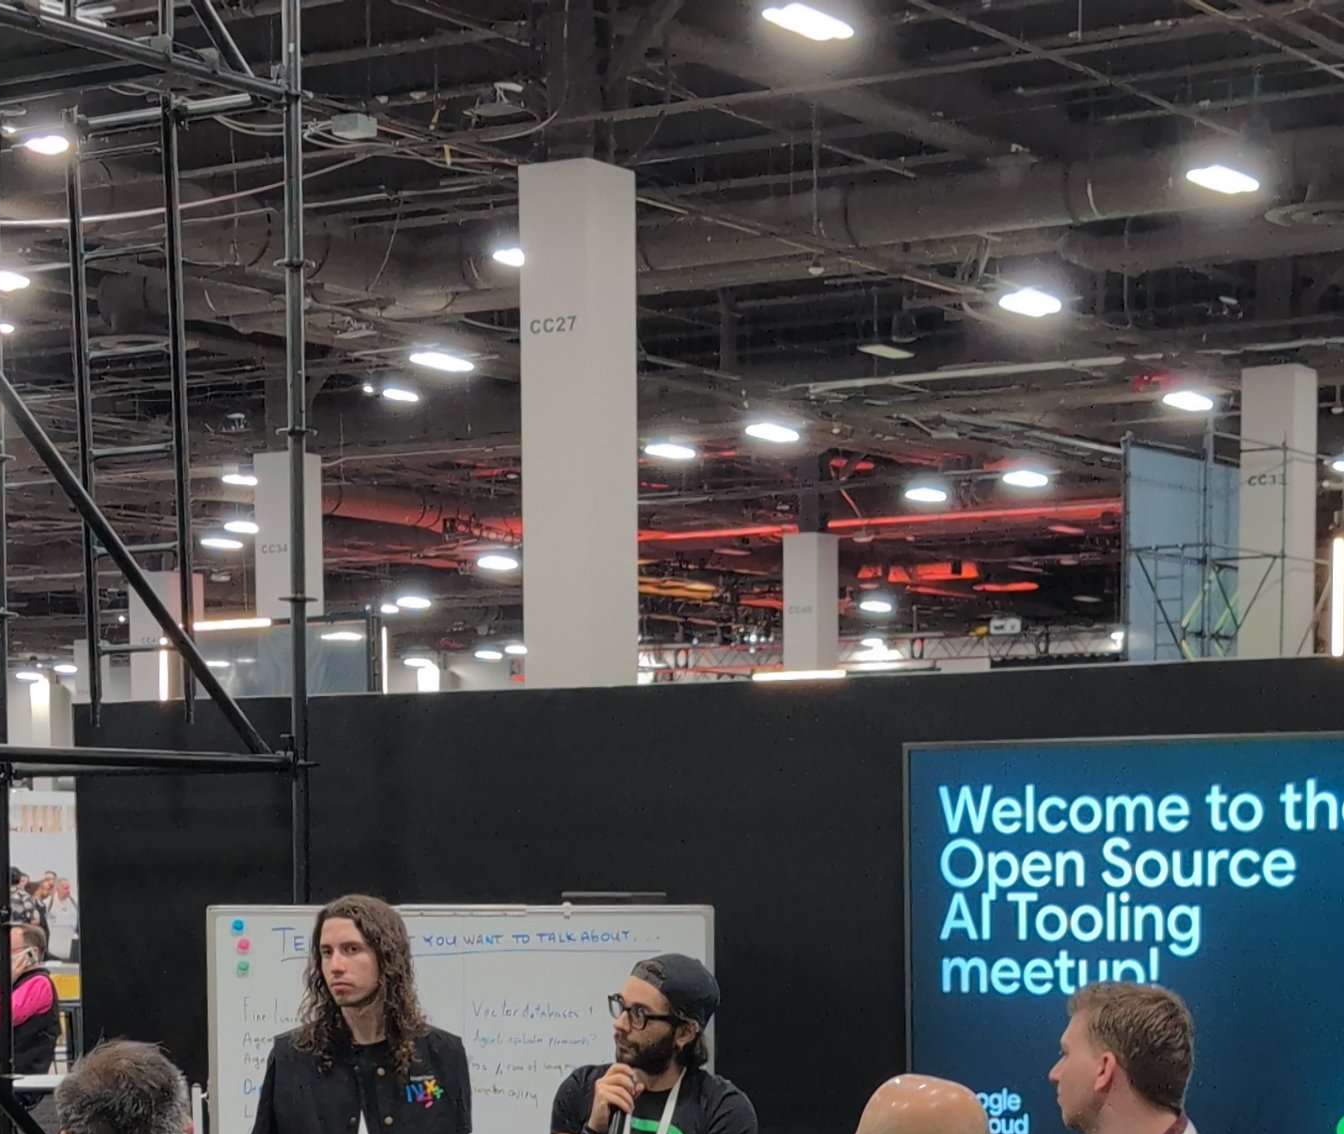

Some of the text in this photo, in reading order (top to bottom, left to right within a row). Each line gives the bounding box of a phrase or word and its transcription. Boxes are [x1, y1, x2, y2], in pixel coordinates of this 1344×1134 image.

[529, 315, 577, 335] CC27
[939, 784, 1190, 834] Welcome
[1206, 784, 1263, 832] to
[940, 837, 1296, 900] Open Source
[272, 927, 311, 953] TE
[423, 935, 456, 948] YOU
[463, 934, 504, 946] WANT
[512, 934, 530, 945] TO
[535, 932, 576, 944] TALK
[940, 892, 1202, 956] AI Tooling
[975, 1087, 1021, 1116] ogle
